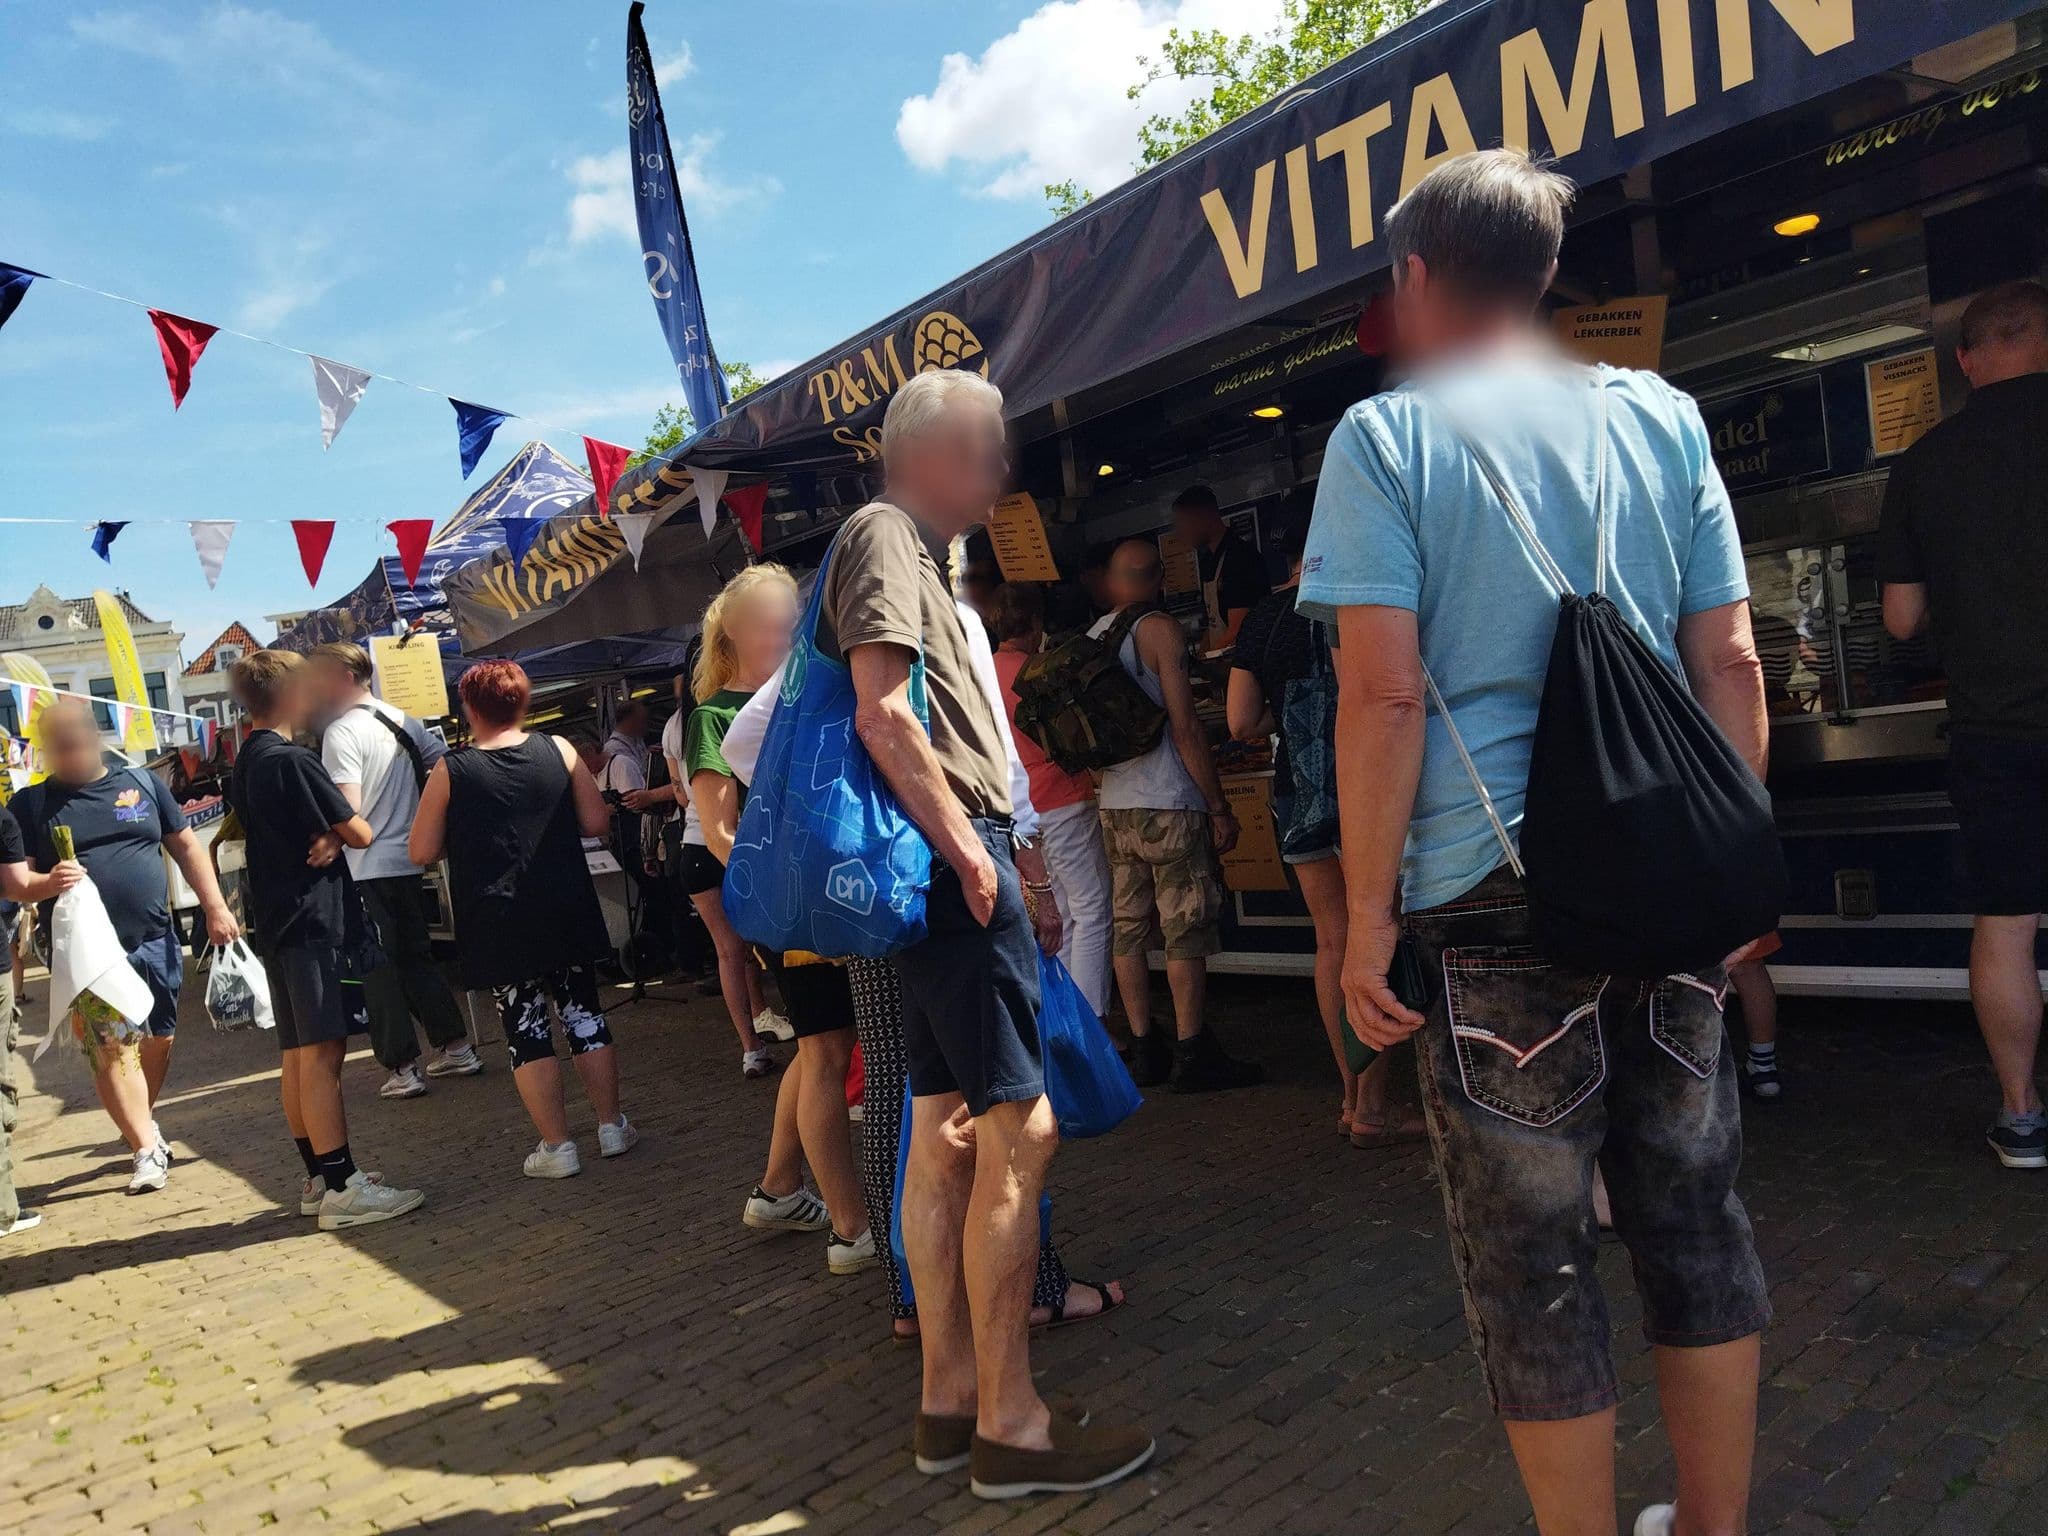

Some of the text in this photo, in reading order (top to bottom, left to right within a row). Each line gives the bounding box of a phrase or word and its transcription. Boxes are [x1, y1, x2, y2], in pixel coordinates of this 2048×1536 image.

[1200, 0, 1855, 298] VITAMIN
[1576, 309, 1643, 323] GEBAKKEN
[1573, 326, 1642, 339] LEKKERBEK
[1883, 354, 1926, 371] GEBAKKEN
[1883, 365, 1928, 381] VISSNACKS
[808, 333, 908, 425] P&M
[1214, 360, 1275, 396] warme
[1713, 409, 1768, 452] del
